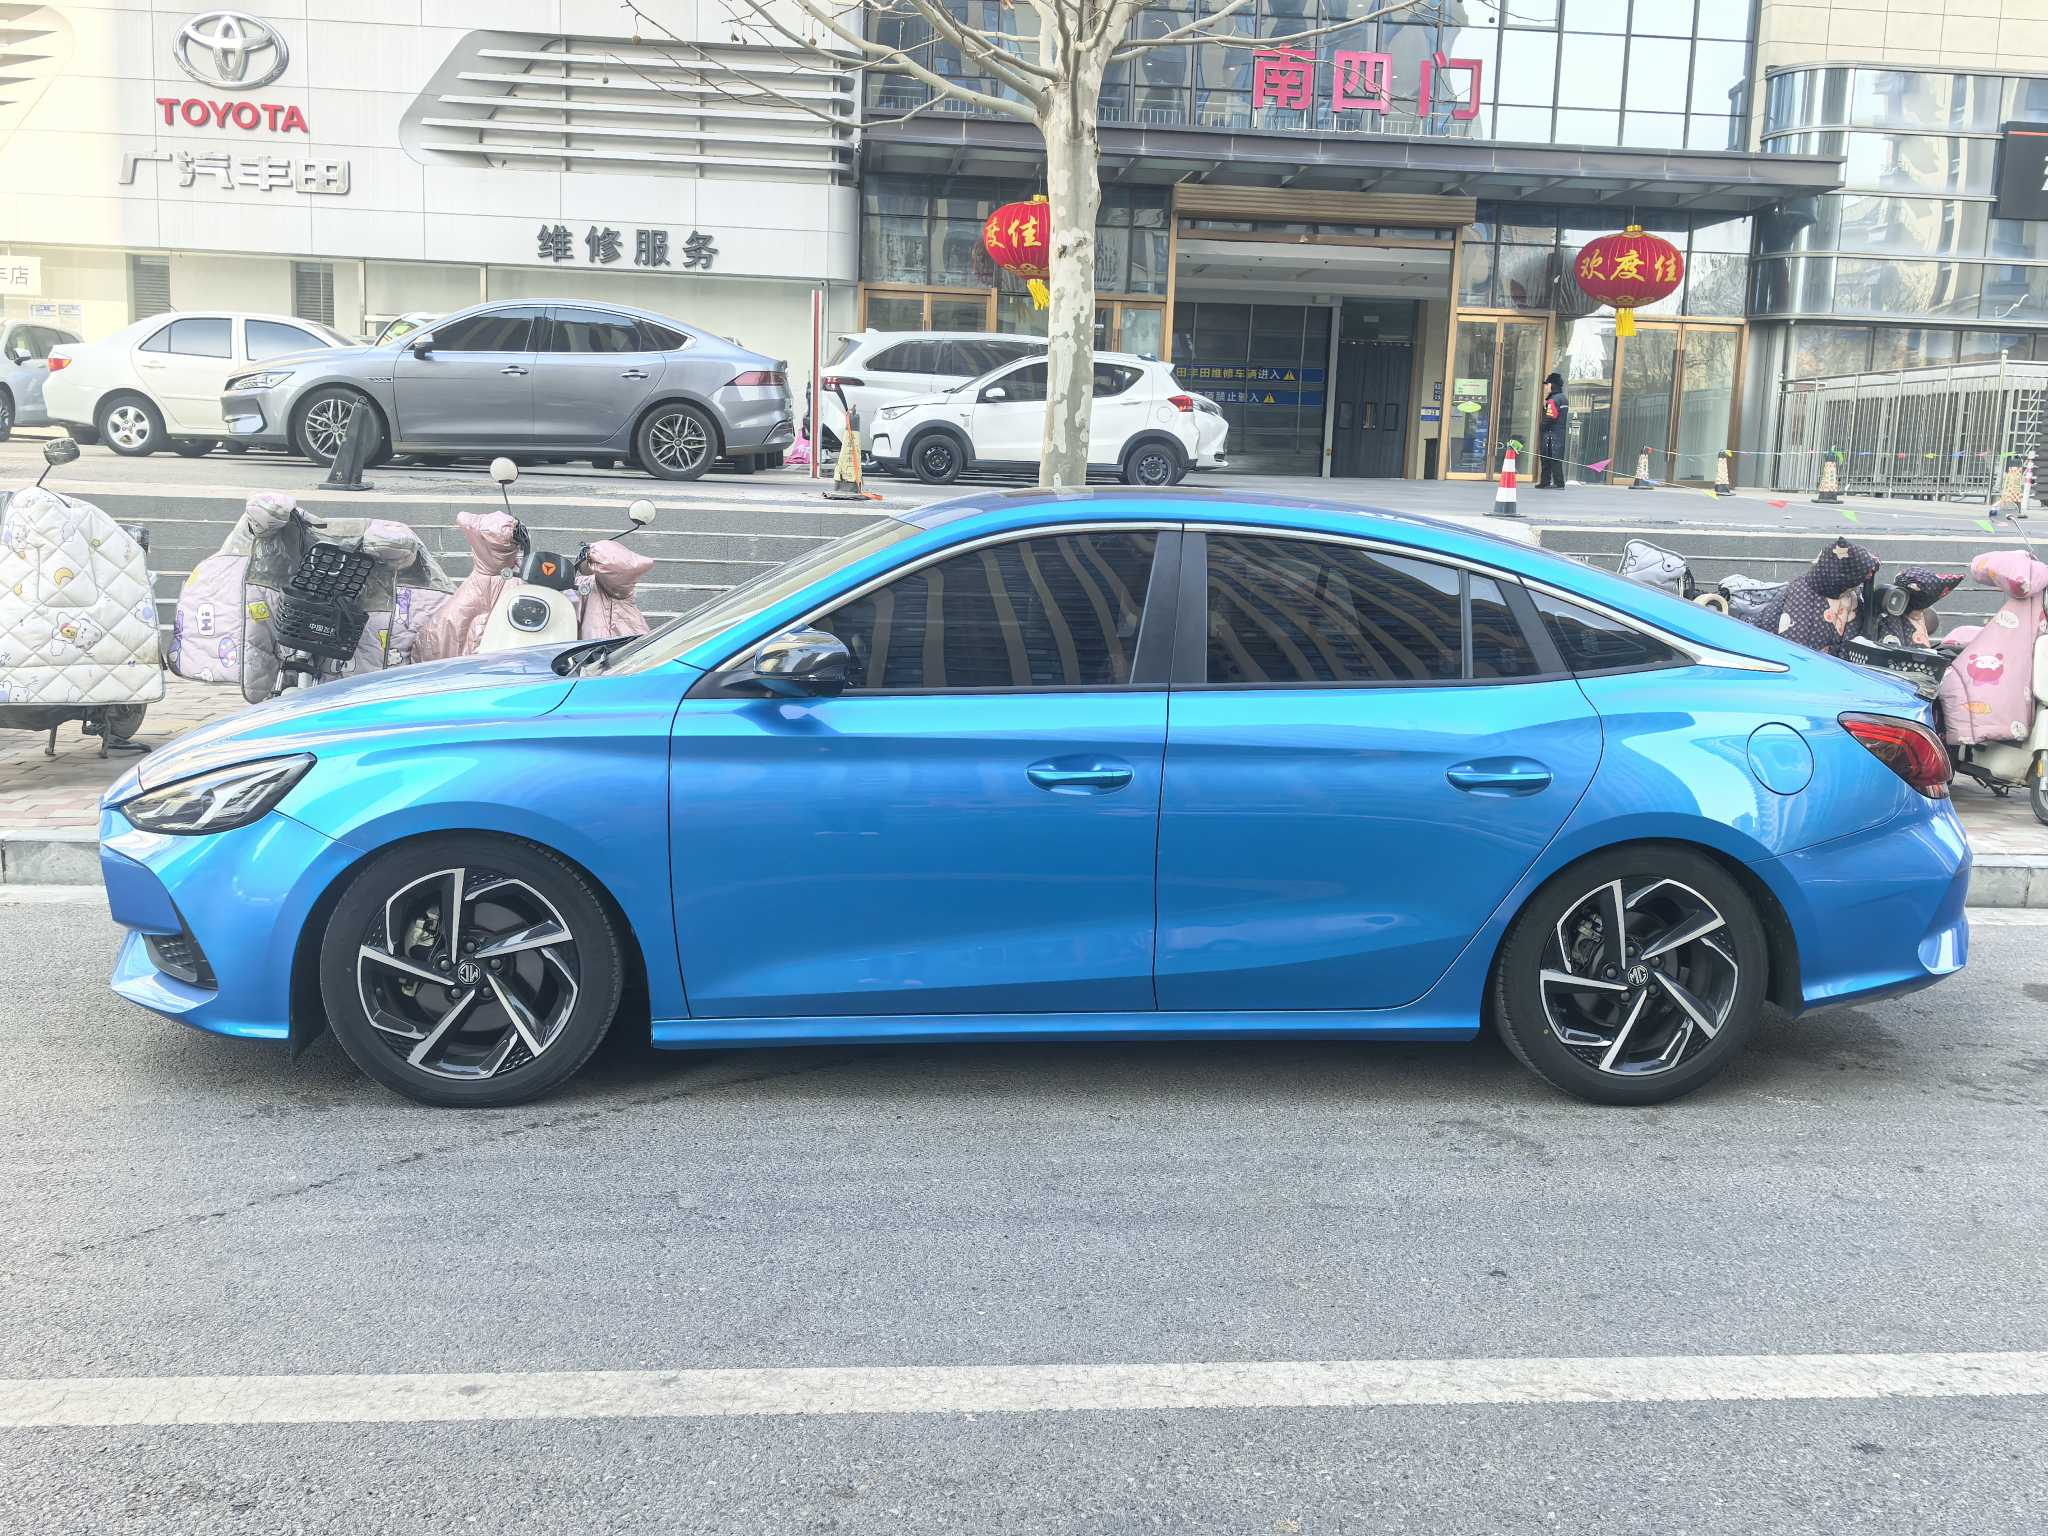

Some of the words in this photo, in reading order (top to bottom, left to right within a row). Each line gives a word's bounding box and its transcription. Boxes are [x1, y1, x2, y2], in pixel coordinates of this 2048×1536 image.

[1253, 43, 1483, 120] 南四门
[155, 97, 309, 133] TOYOTA
[118, 150, 350, 195] 广汽丰田
[536, 223, 720, 269] 维修服务
[1580, 249, 1677, 282] 欢度佳
[1629, 966, 1648, 985] MG
